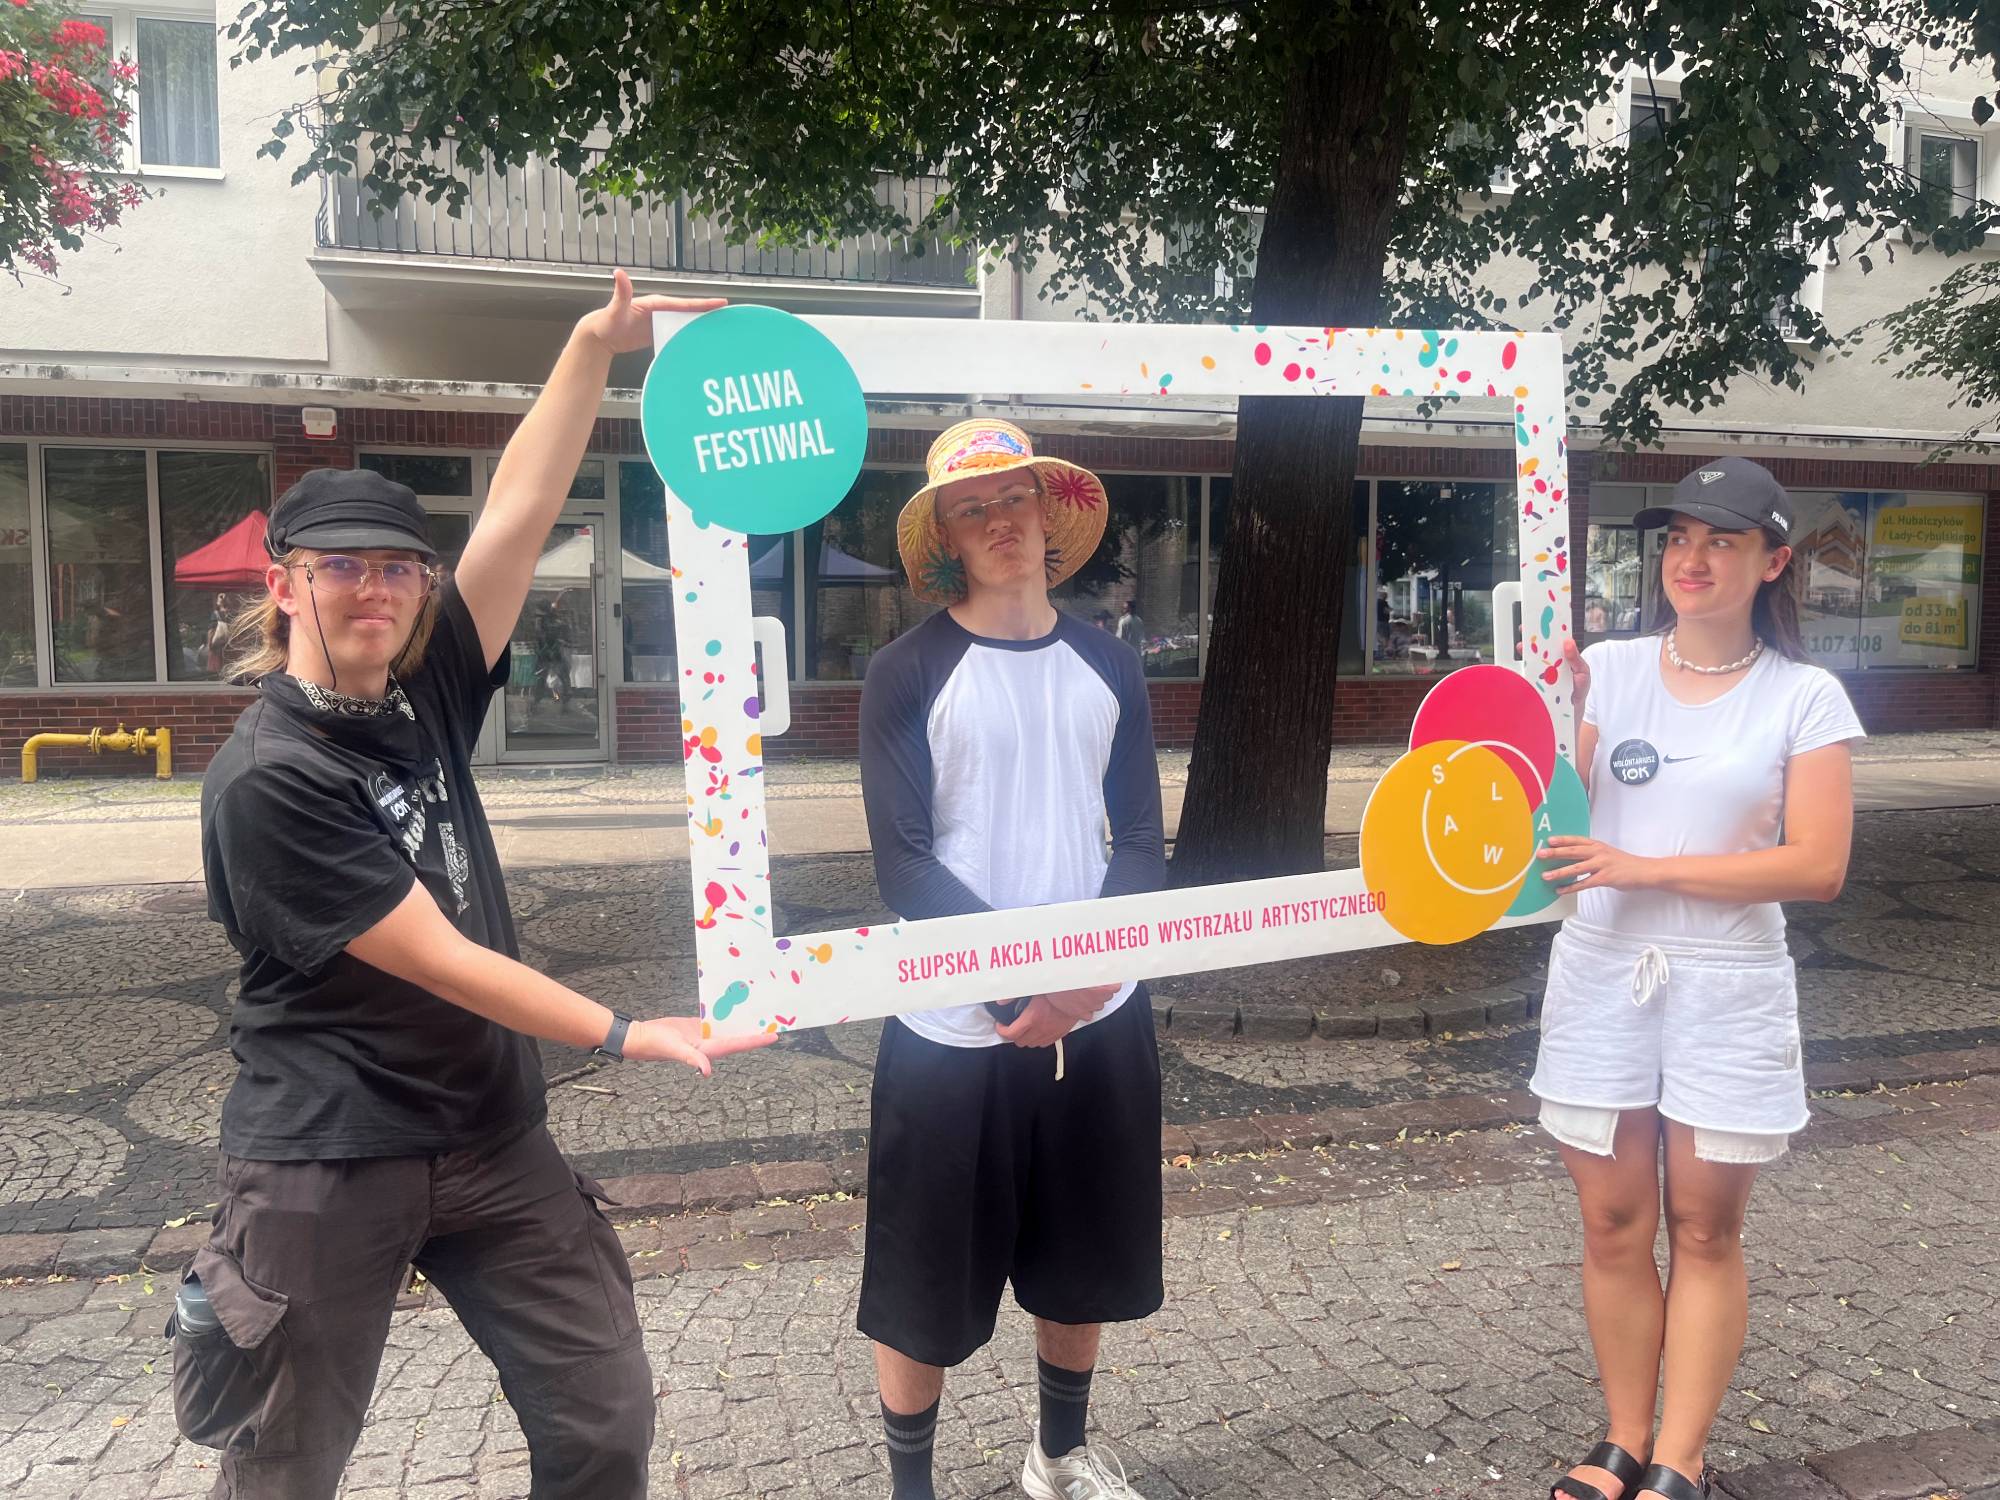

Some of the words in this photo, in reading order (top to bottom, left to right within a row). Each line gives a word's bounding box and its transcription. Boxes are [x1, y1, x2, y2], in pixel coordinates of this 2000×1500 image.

[703, 369, 804, 417] SALWA
[693, 418, 835, 473] FESTIWAL
[1905, 604, 1922, 616] od
[1926, 604, 1942, 616] 33
[1904, 622, 1921, 634] do
[1925, 622, 1941, 634] 81
[1811, 635, 1844, 652] 107
[1850, 635, 1882, 652] 108
[1622, 766, 1650, 781] SOK
[390, 798, 411, 821] SOK
[898, 950, 980, 983] SŁUPSKA
[989, 940, 1043, 969] AKCJA
[1052, 924, 1149, 960] LOKALNEGO
[1158, 909, 1253, 944] WYSTRZAŁU
[1261, 890, 1386, 929] ARTYSTYCZNEGO
